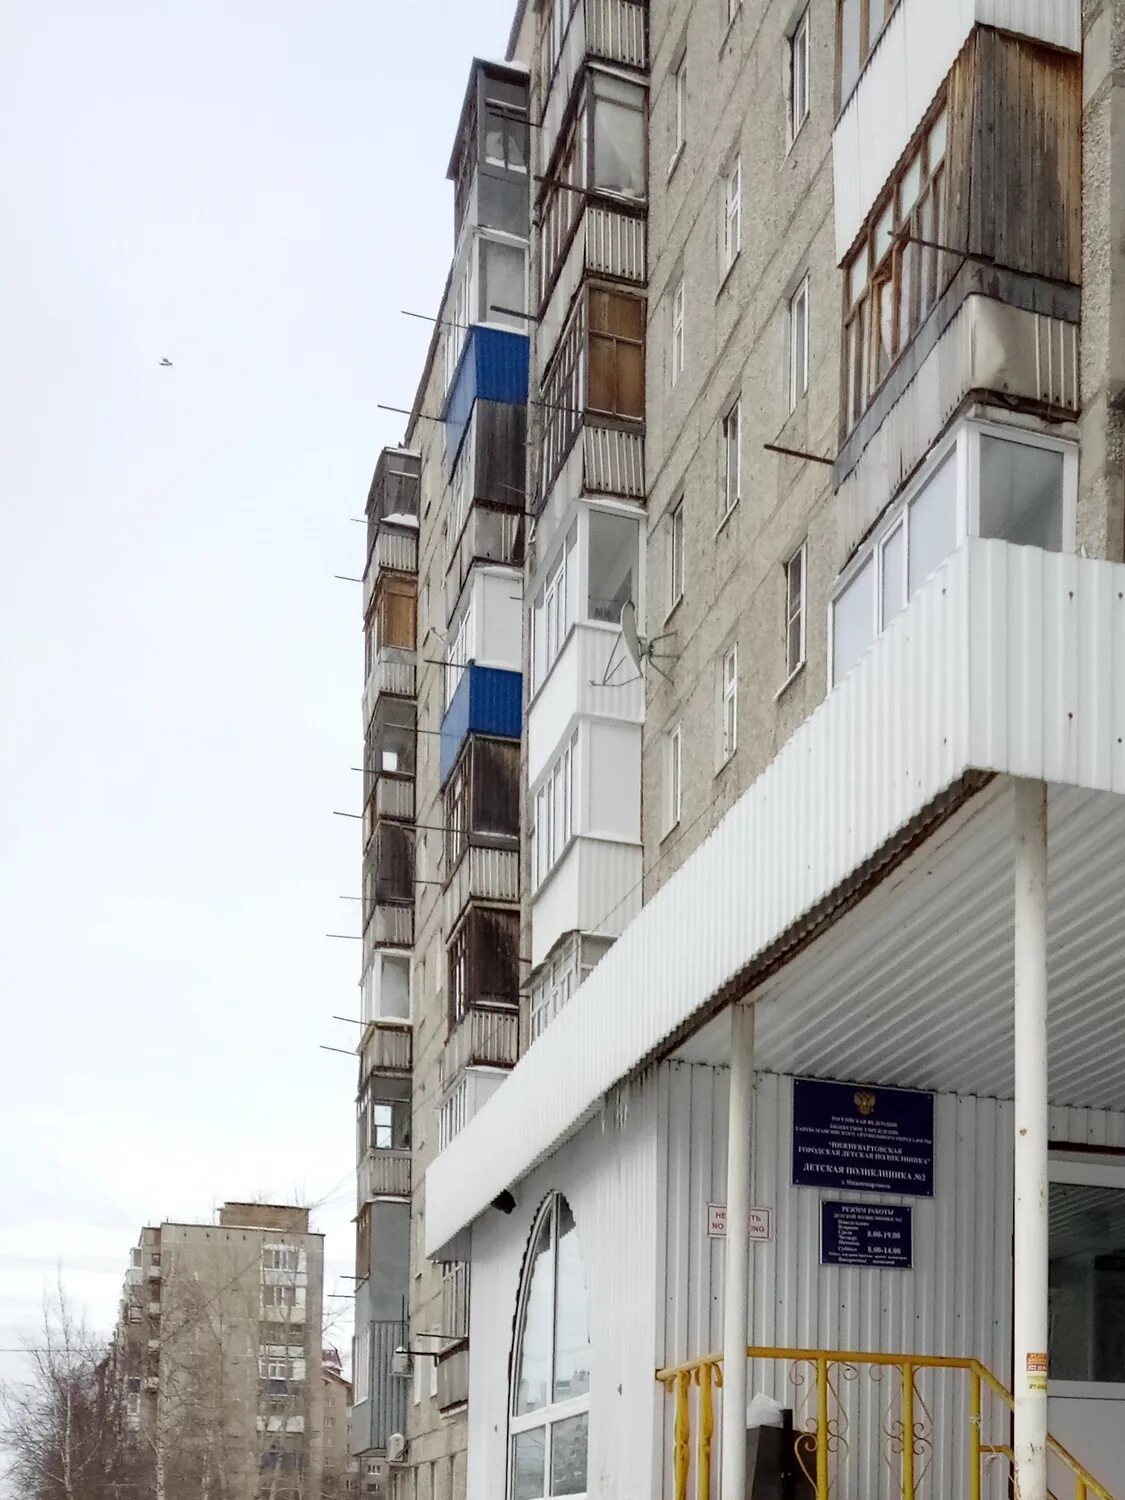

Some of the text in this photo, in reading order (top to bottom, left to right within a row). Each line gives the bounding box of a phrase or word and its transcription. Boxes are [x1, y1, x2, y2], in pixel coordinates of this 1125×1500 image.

[798, 1146, 841, 1156] ГОРОДСКАЯ
[841, 1149, 874, 1159] ДЕТСКАЯ
[803, 1163, 926, 1182] ДЕТСКАЯ ПОЛИКЛИНИКА №2
[841, 1205, 867, 1214] РЕЖИМ
[712, 1222, 724, 1230] NO
